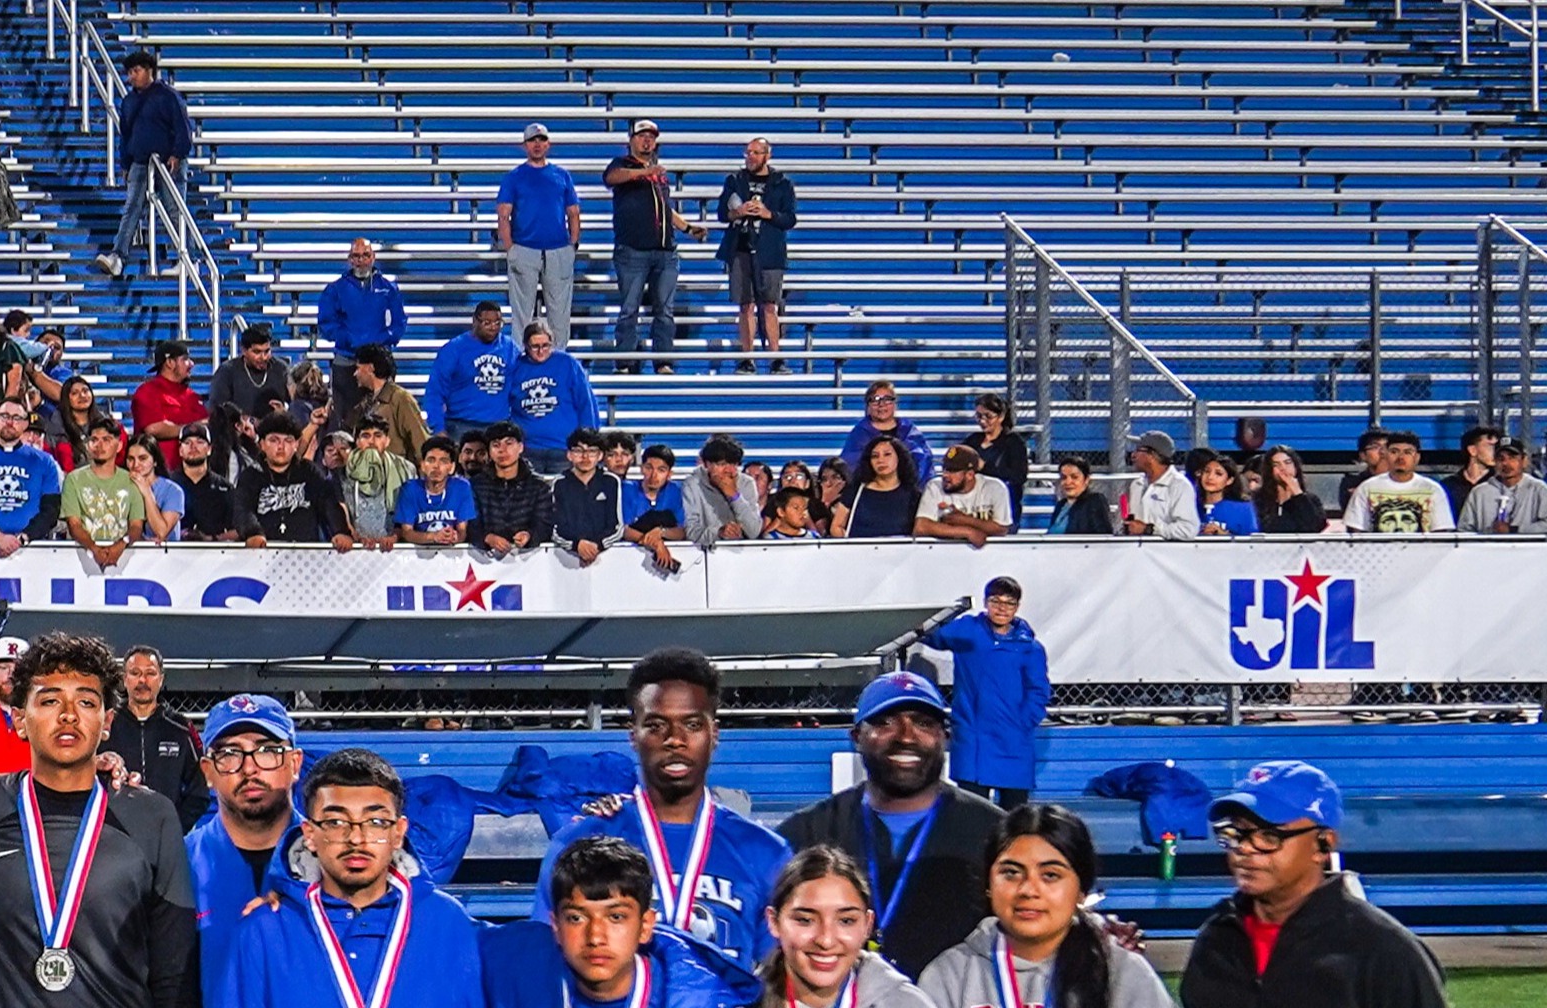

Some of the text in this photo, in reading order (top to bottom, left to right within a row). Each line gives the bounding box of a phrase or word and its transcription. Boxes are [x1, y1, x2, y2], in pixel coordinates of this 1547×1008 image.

[473, 354, 506, 368] ROYAL
[521, 376, 557, 390] ROYAL
[521, 396, 558, 408] FALCONS
[418, 510, 457, 524] ROYAL
[1229, 579, 1375, 671] UIL
[44, 960, 68, 977] UIL
